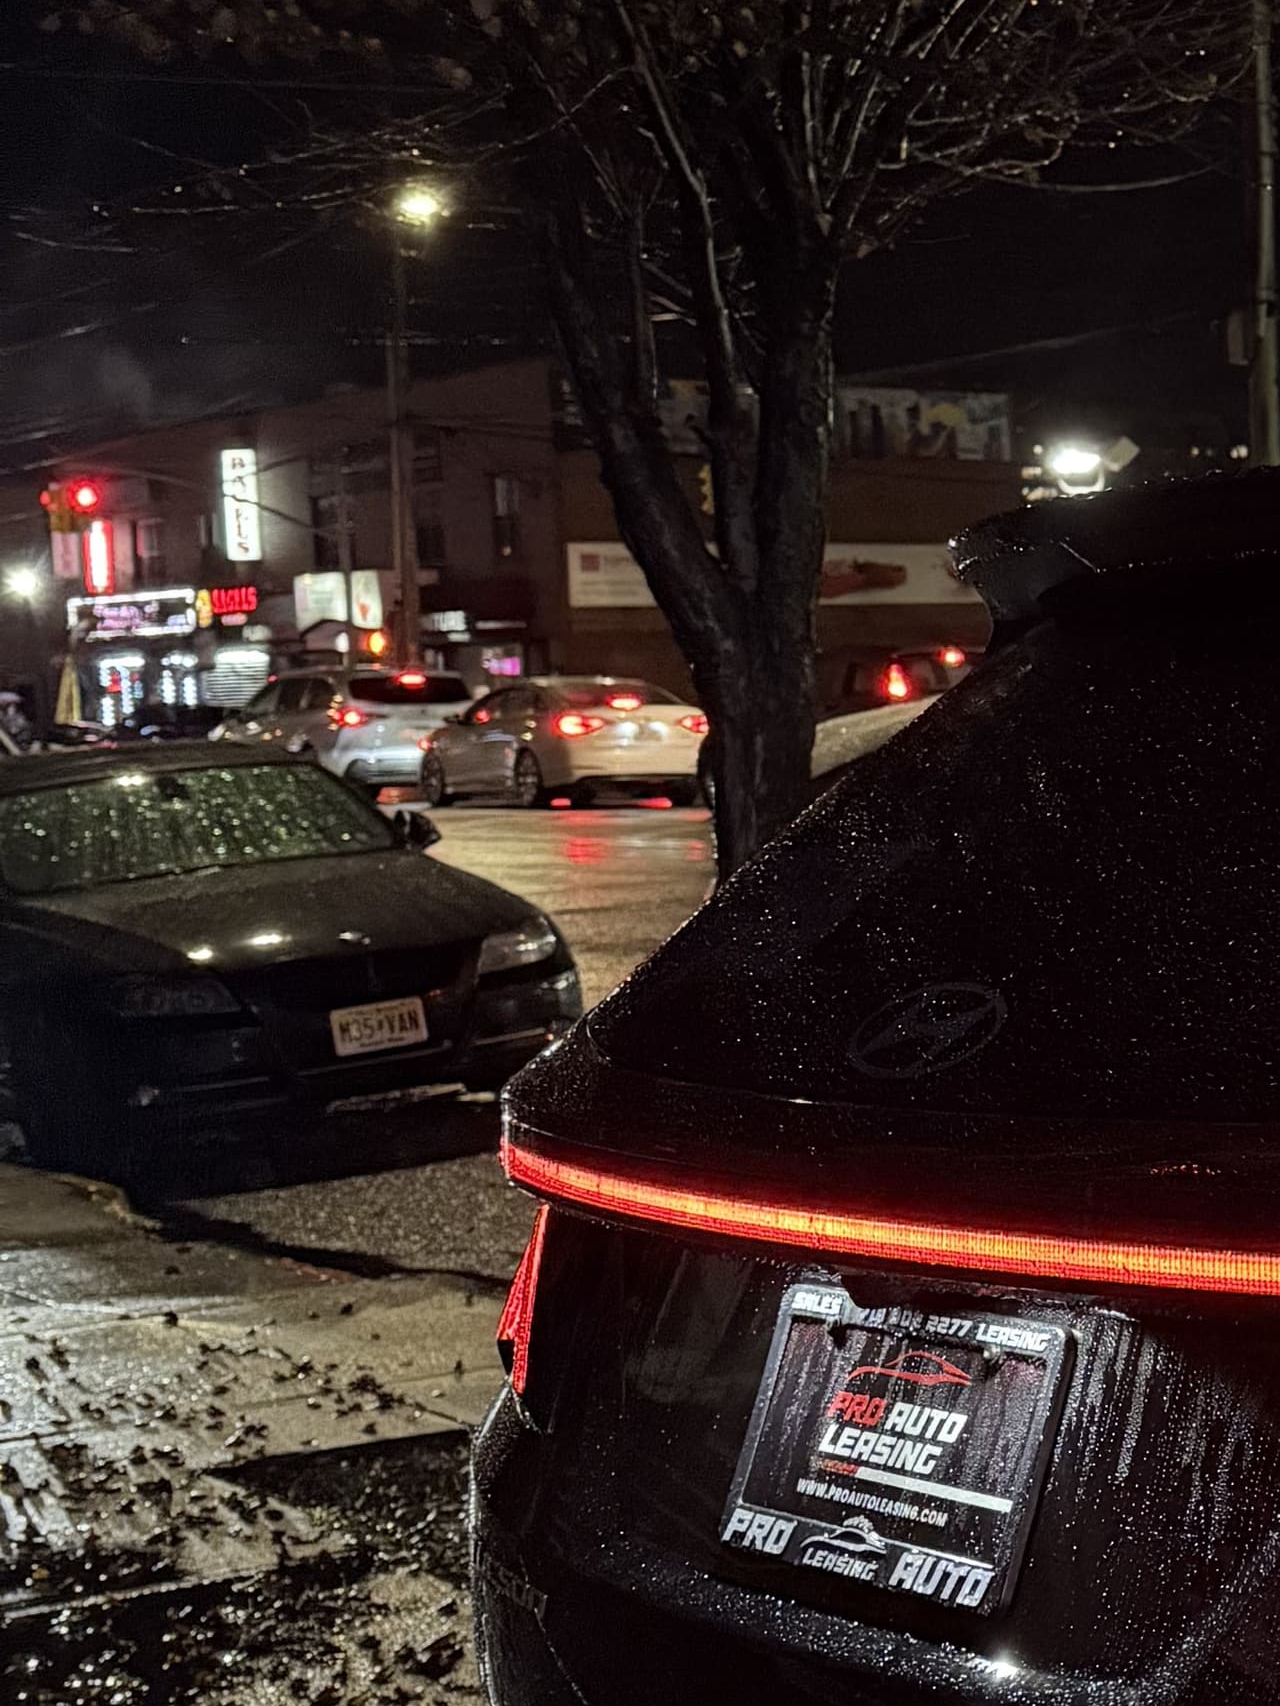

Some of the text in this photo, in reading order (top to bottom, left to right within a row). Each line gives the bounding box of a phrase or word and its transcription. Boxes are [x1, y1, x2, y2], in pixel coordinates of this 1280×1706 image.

[791, 1292, 841, 1315] SALES
[924, 1314, 972, 1337] 2277
[975, 1322, 1049, 1352] LEASING
[827, 1390, 968, 1443] PRO AUTO
[819, 1423, 943, 1475] LEASING
[721, 1508, 996, 1607] PRO AUTO
[802, 1546, 880, 1581] LEASING
